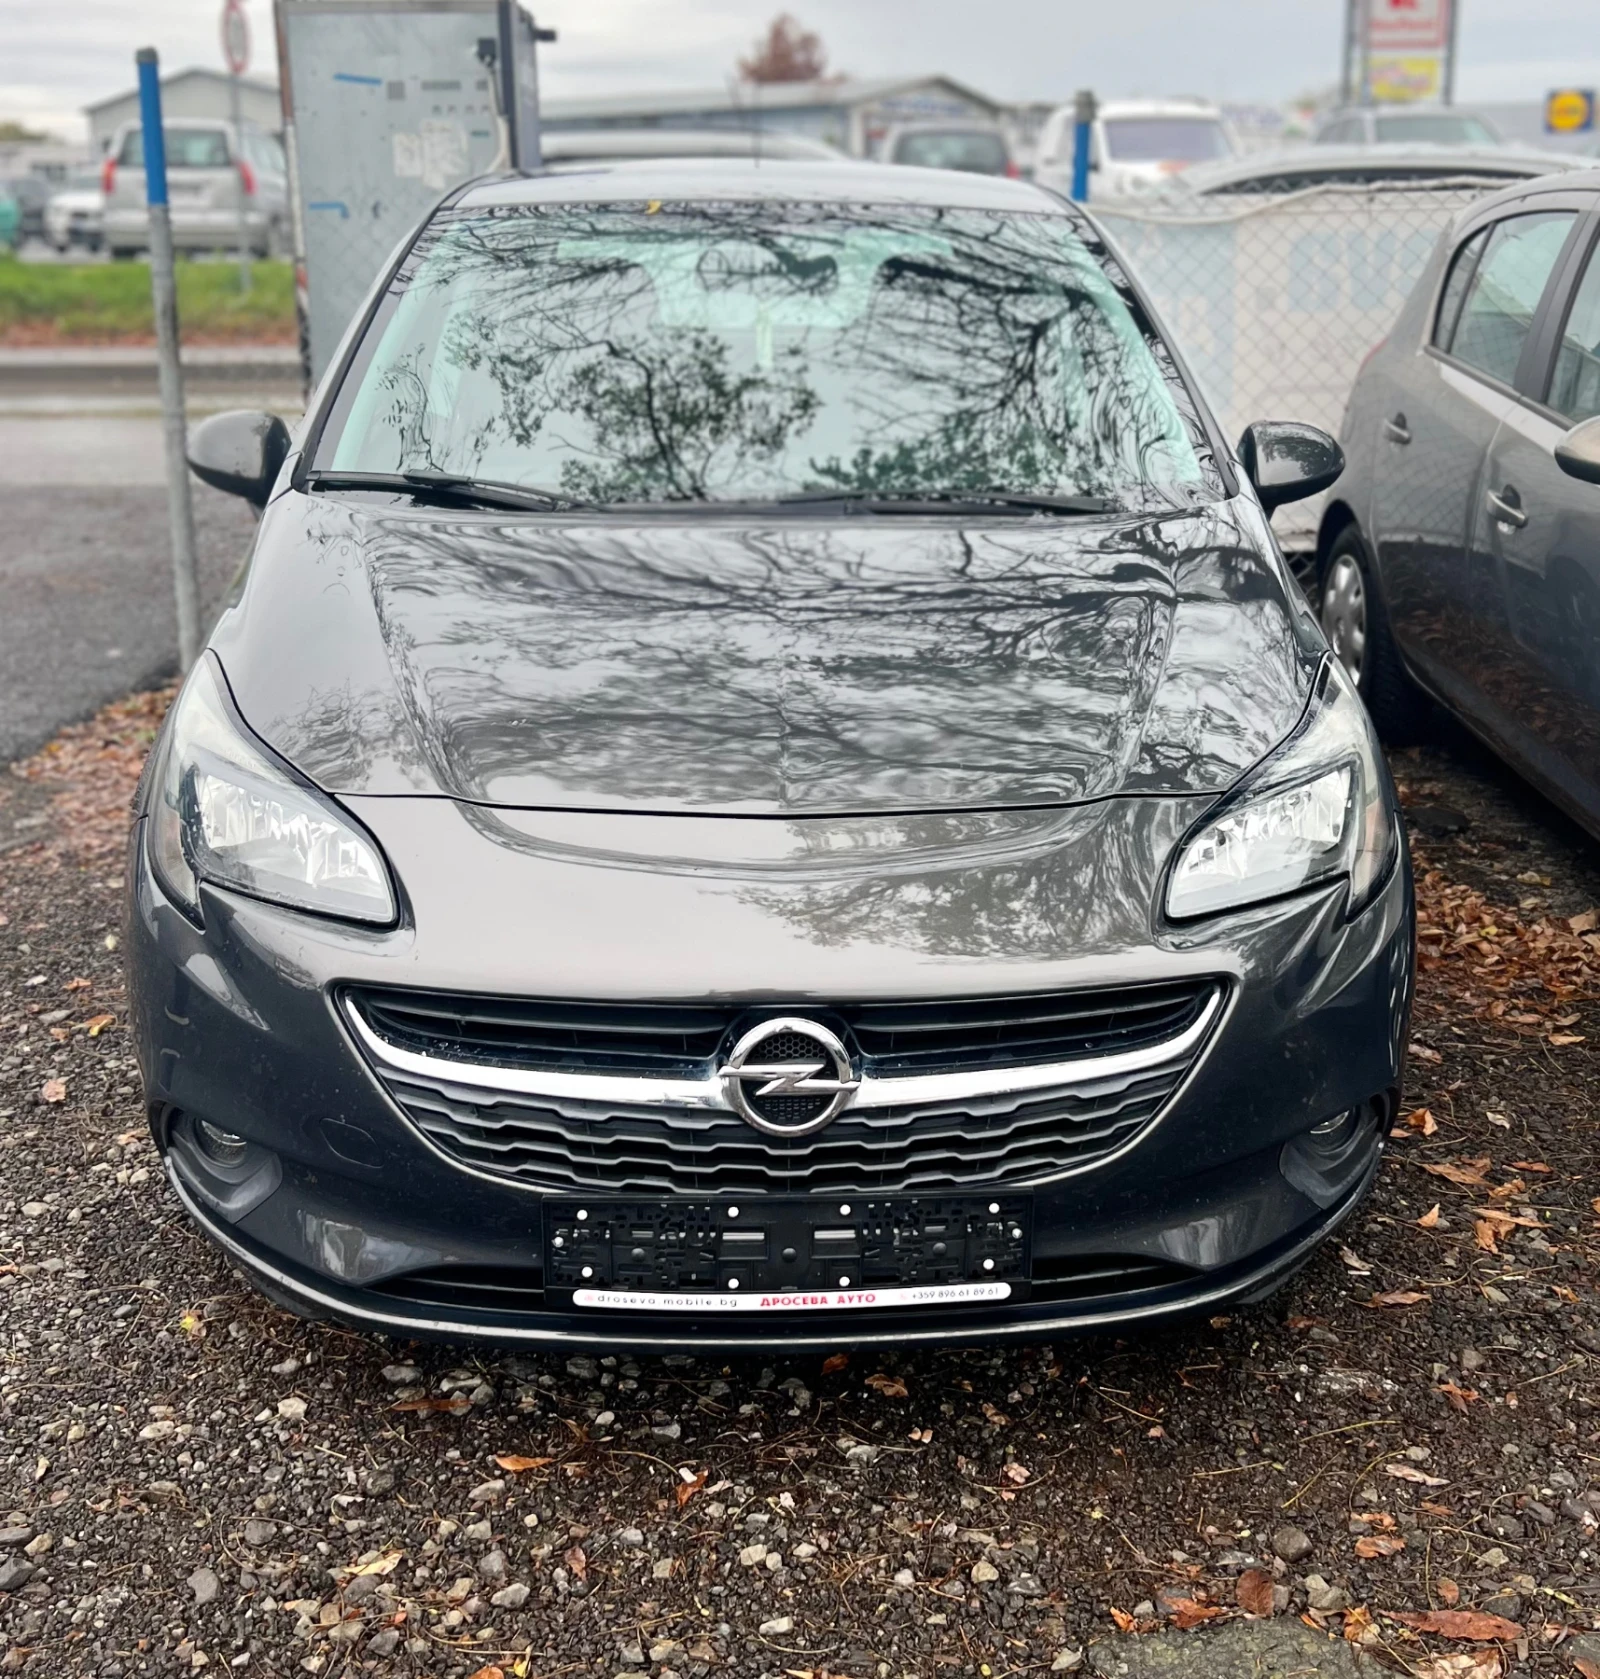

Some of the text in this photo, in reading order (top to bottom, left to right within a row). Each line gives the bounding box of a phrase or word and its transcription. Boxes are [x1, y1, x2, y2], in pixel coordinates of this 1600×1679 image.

[912, 1287, 998, 1299] +359 896 61 89 61
[760, 1293, 876, 1307] ДРОСЕВА АУТО
